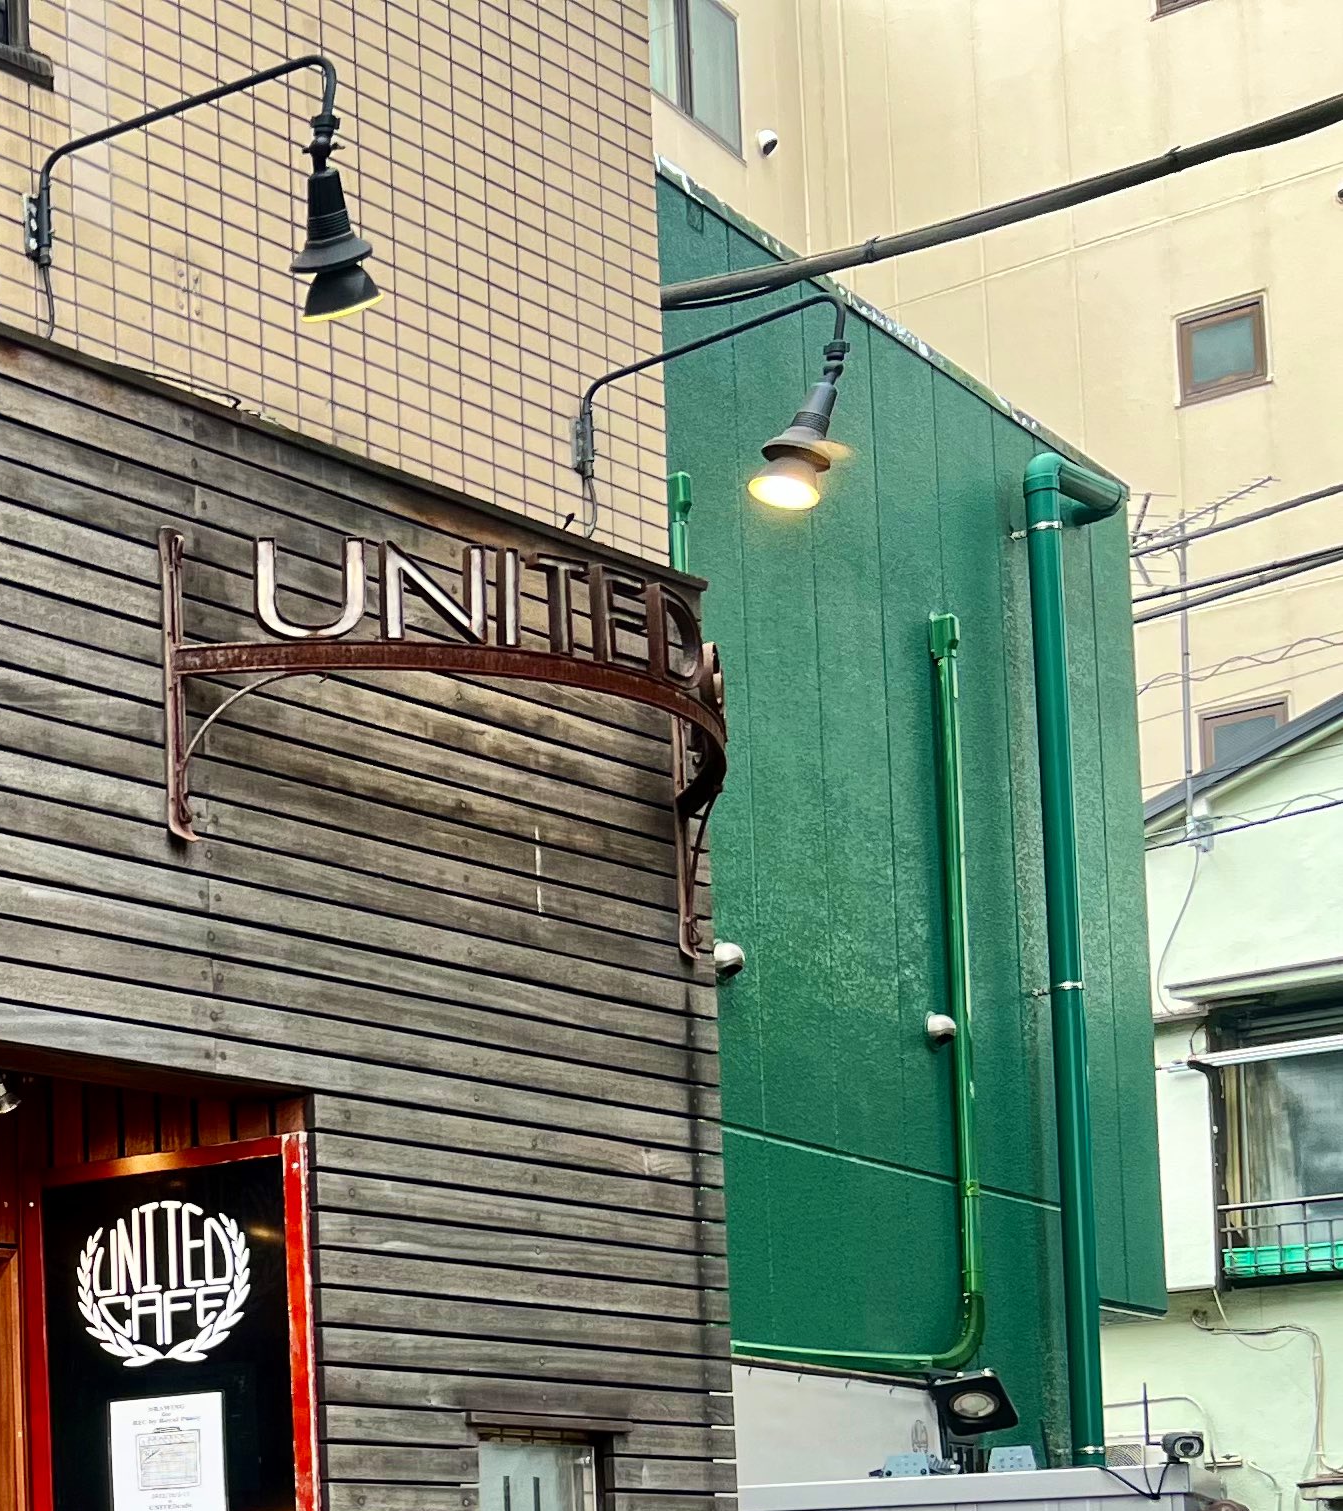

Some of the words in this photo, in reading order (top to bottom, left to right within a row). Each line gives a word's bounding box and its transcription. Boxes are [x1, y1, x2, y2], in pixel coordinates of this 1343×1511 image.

[253, 536, 704, 688] UNITED
[92, 1200, 234, 1297] UNITED
[98, 1285, 232, 1346] CAFE
